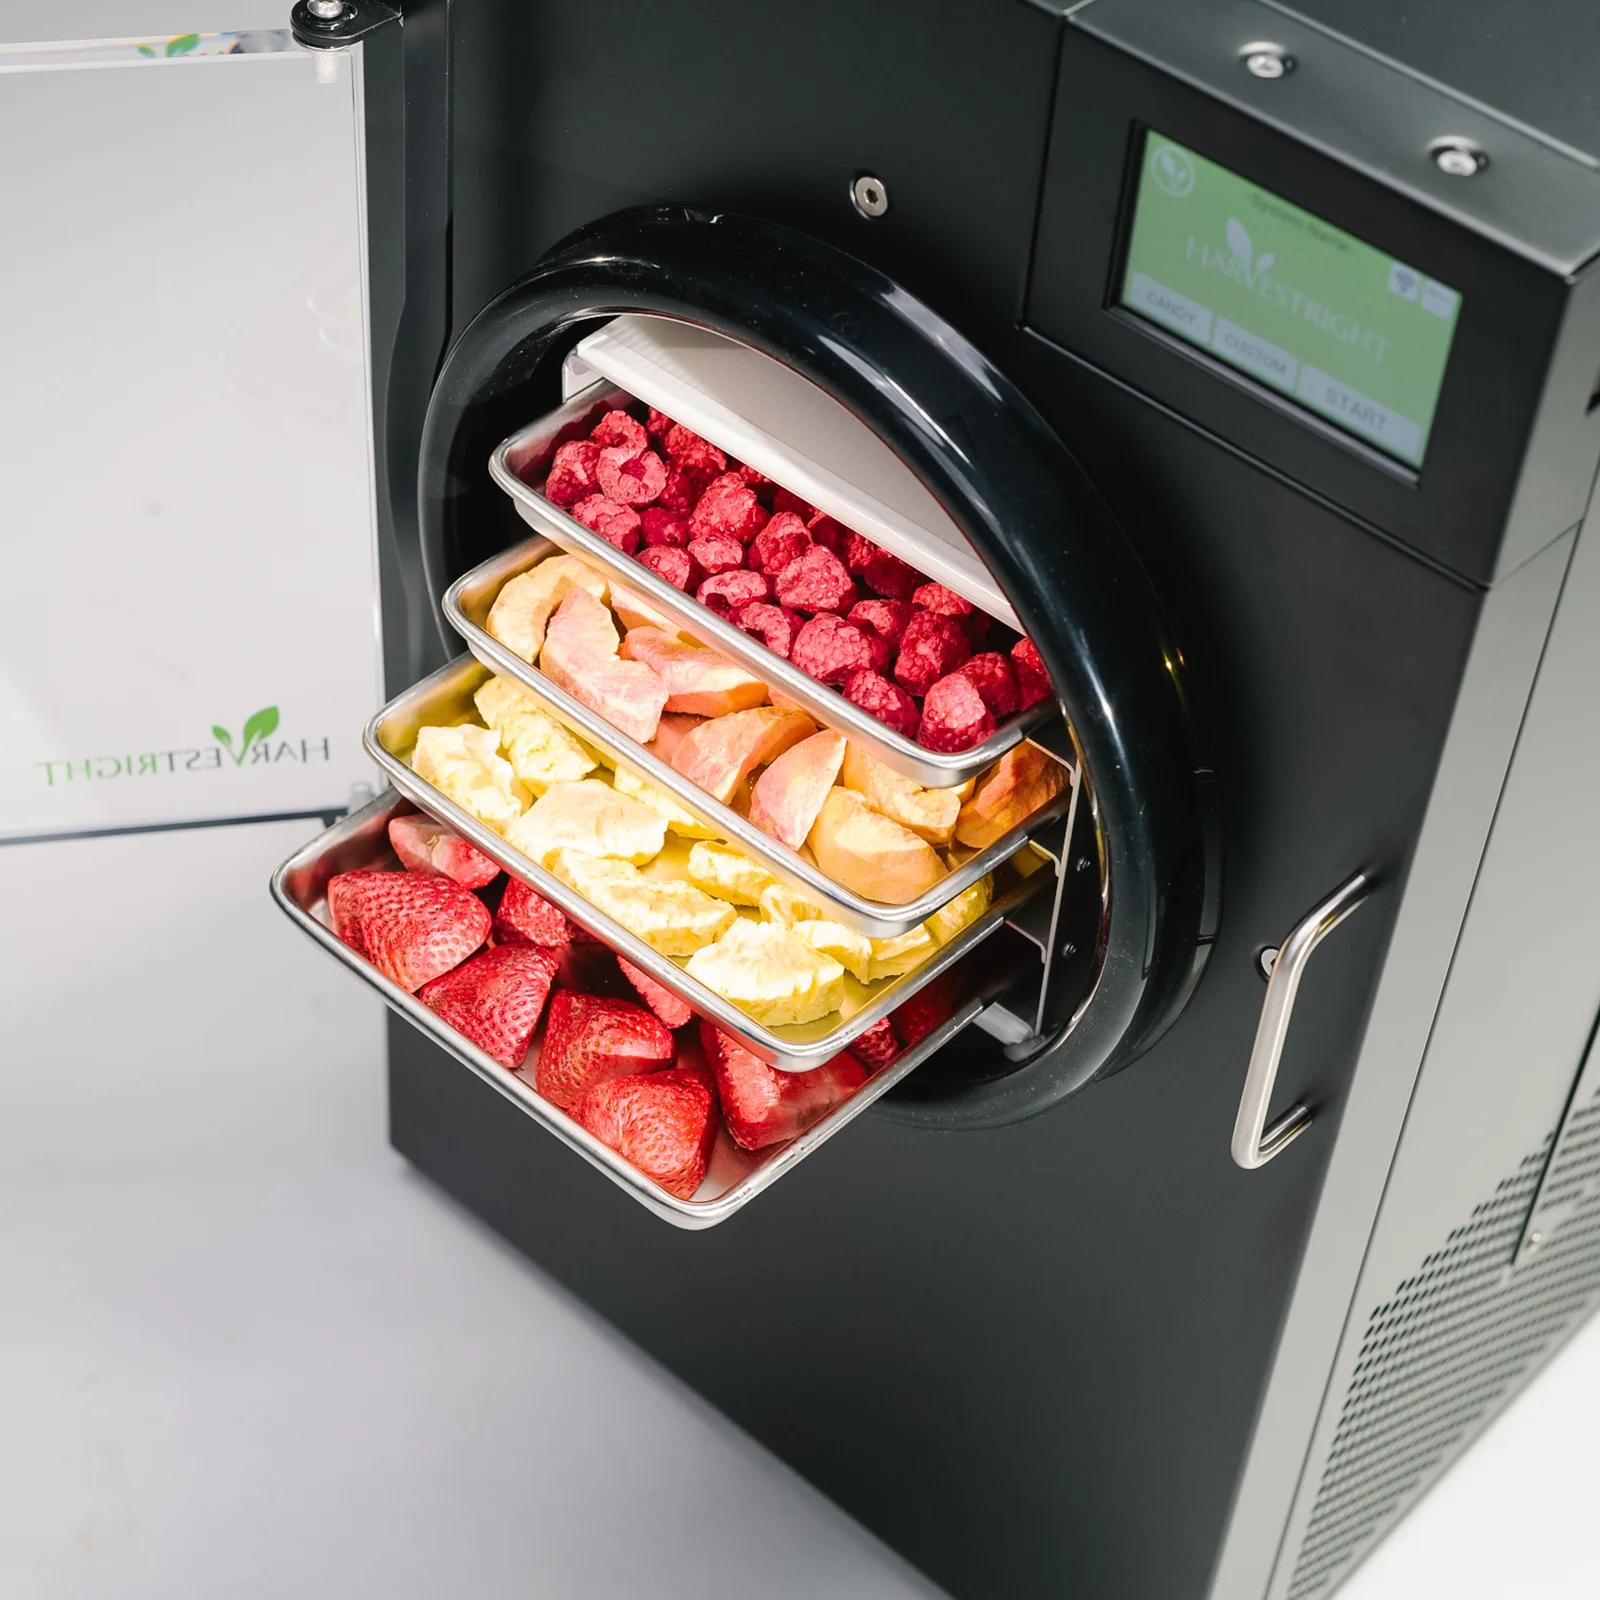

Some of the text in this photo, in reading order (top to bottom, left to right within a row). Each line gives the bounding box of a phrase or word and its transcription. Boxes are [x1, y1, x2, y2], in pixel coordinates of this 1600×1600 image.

[1147, 291, 1196, 325] CANDY
[1224, 333, 1287, 375] CUSTOM
[1325, 386, 1388, 431] START
